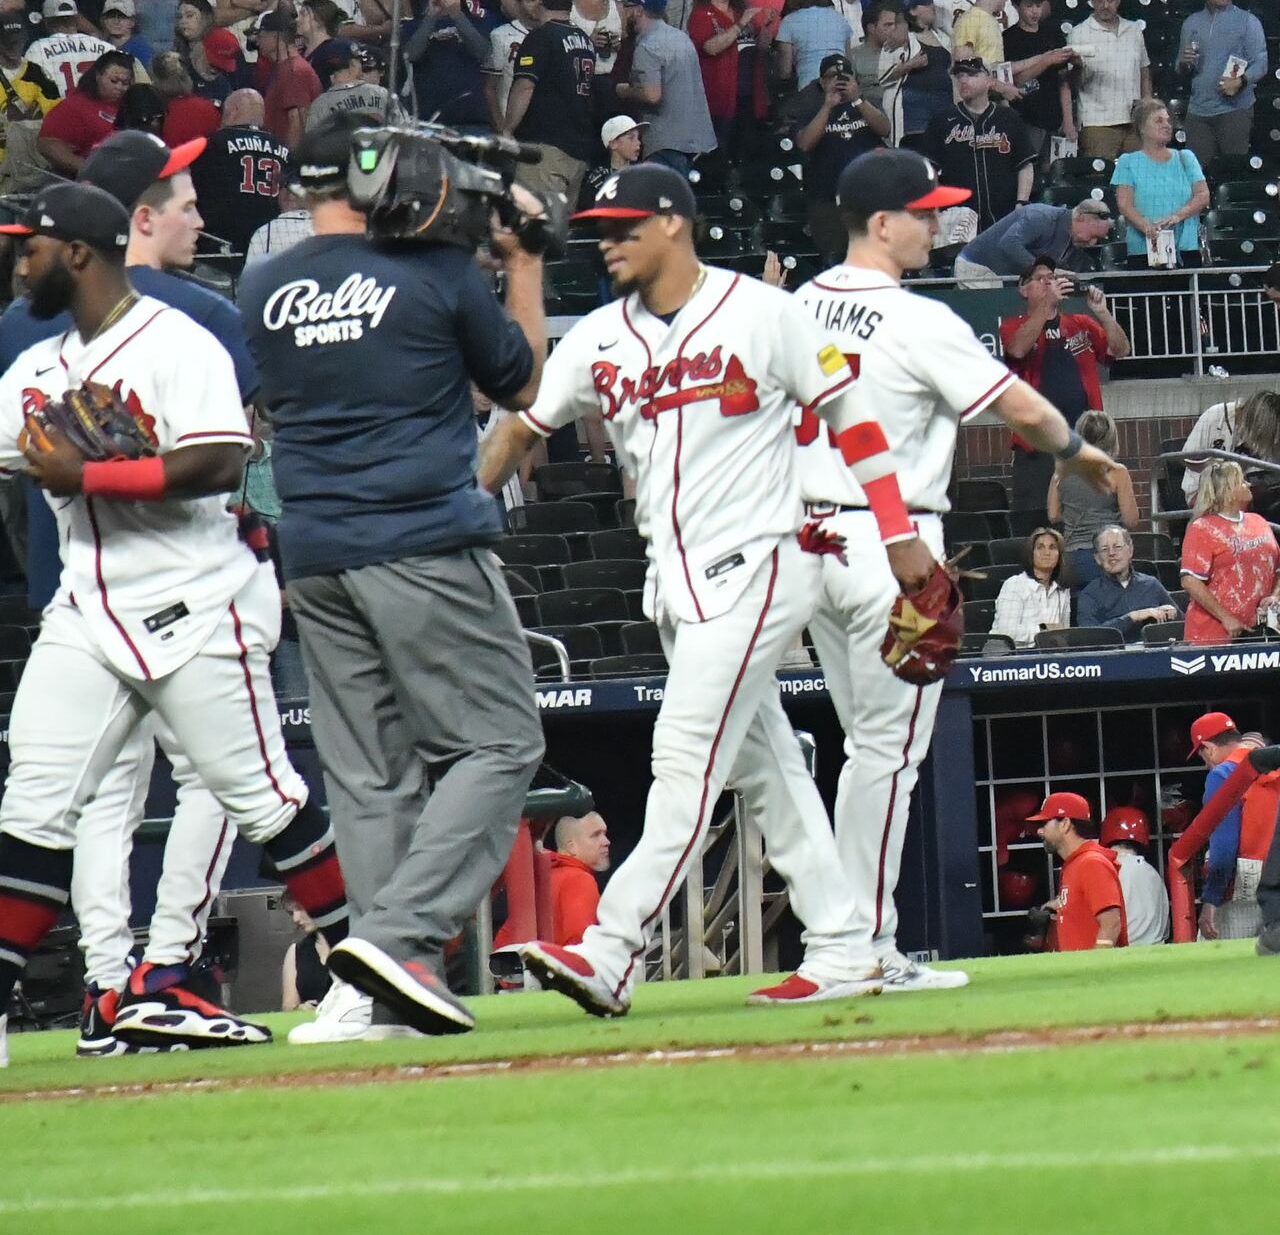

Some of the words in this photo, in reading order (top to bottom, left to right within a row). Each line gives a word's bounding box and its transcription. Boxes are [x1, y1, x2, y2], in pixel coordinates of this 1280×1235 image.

[43, 41, 87, 60] ACUÑA
[227, 135, 273, 155] ACUÑA
[240, 154, 282, 198] 13
[263, 273, 398, 331] Bally
[295, 320, 363, 347] SPORTS
[591, 344, 723, 421] Braves
[968, 663, 1101, 684] YanmarUS.com
[538, 688, 592, 708] MAR
[777, 675, 830, 698] mpact
